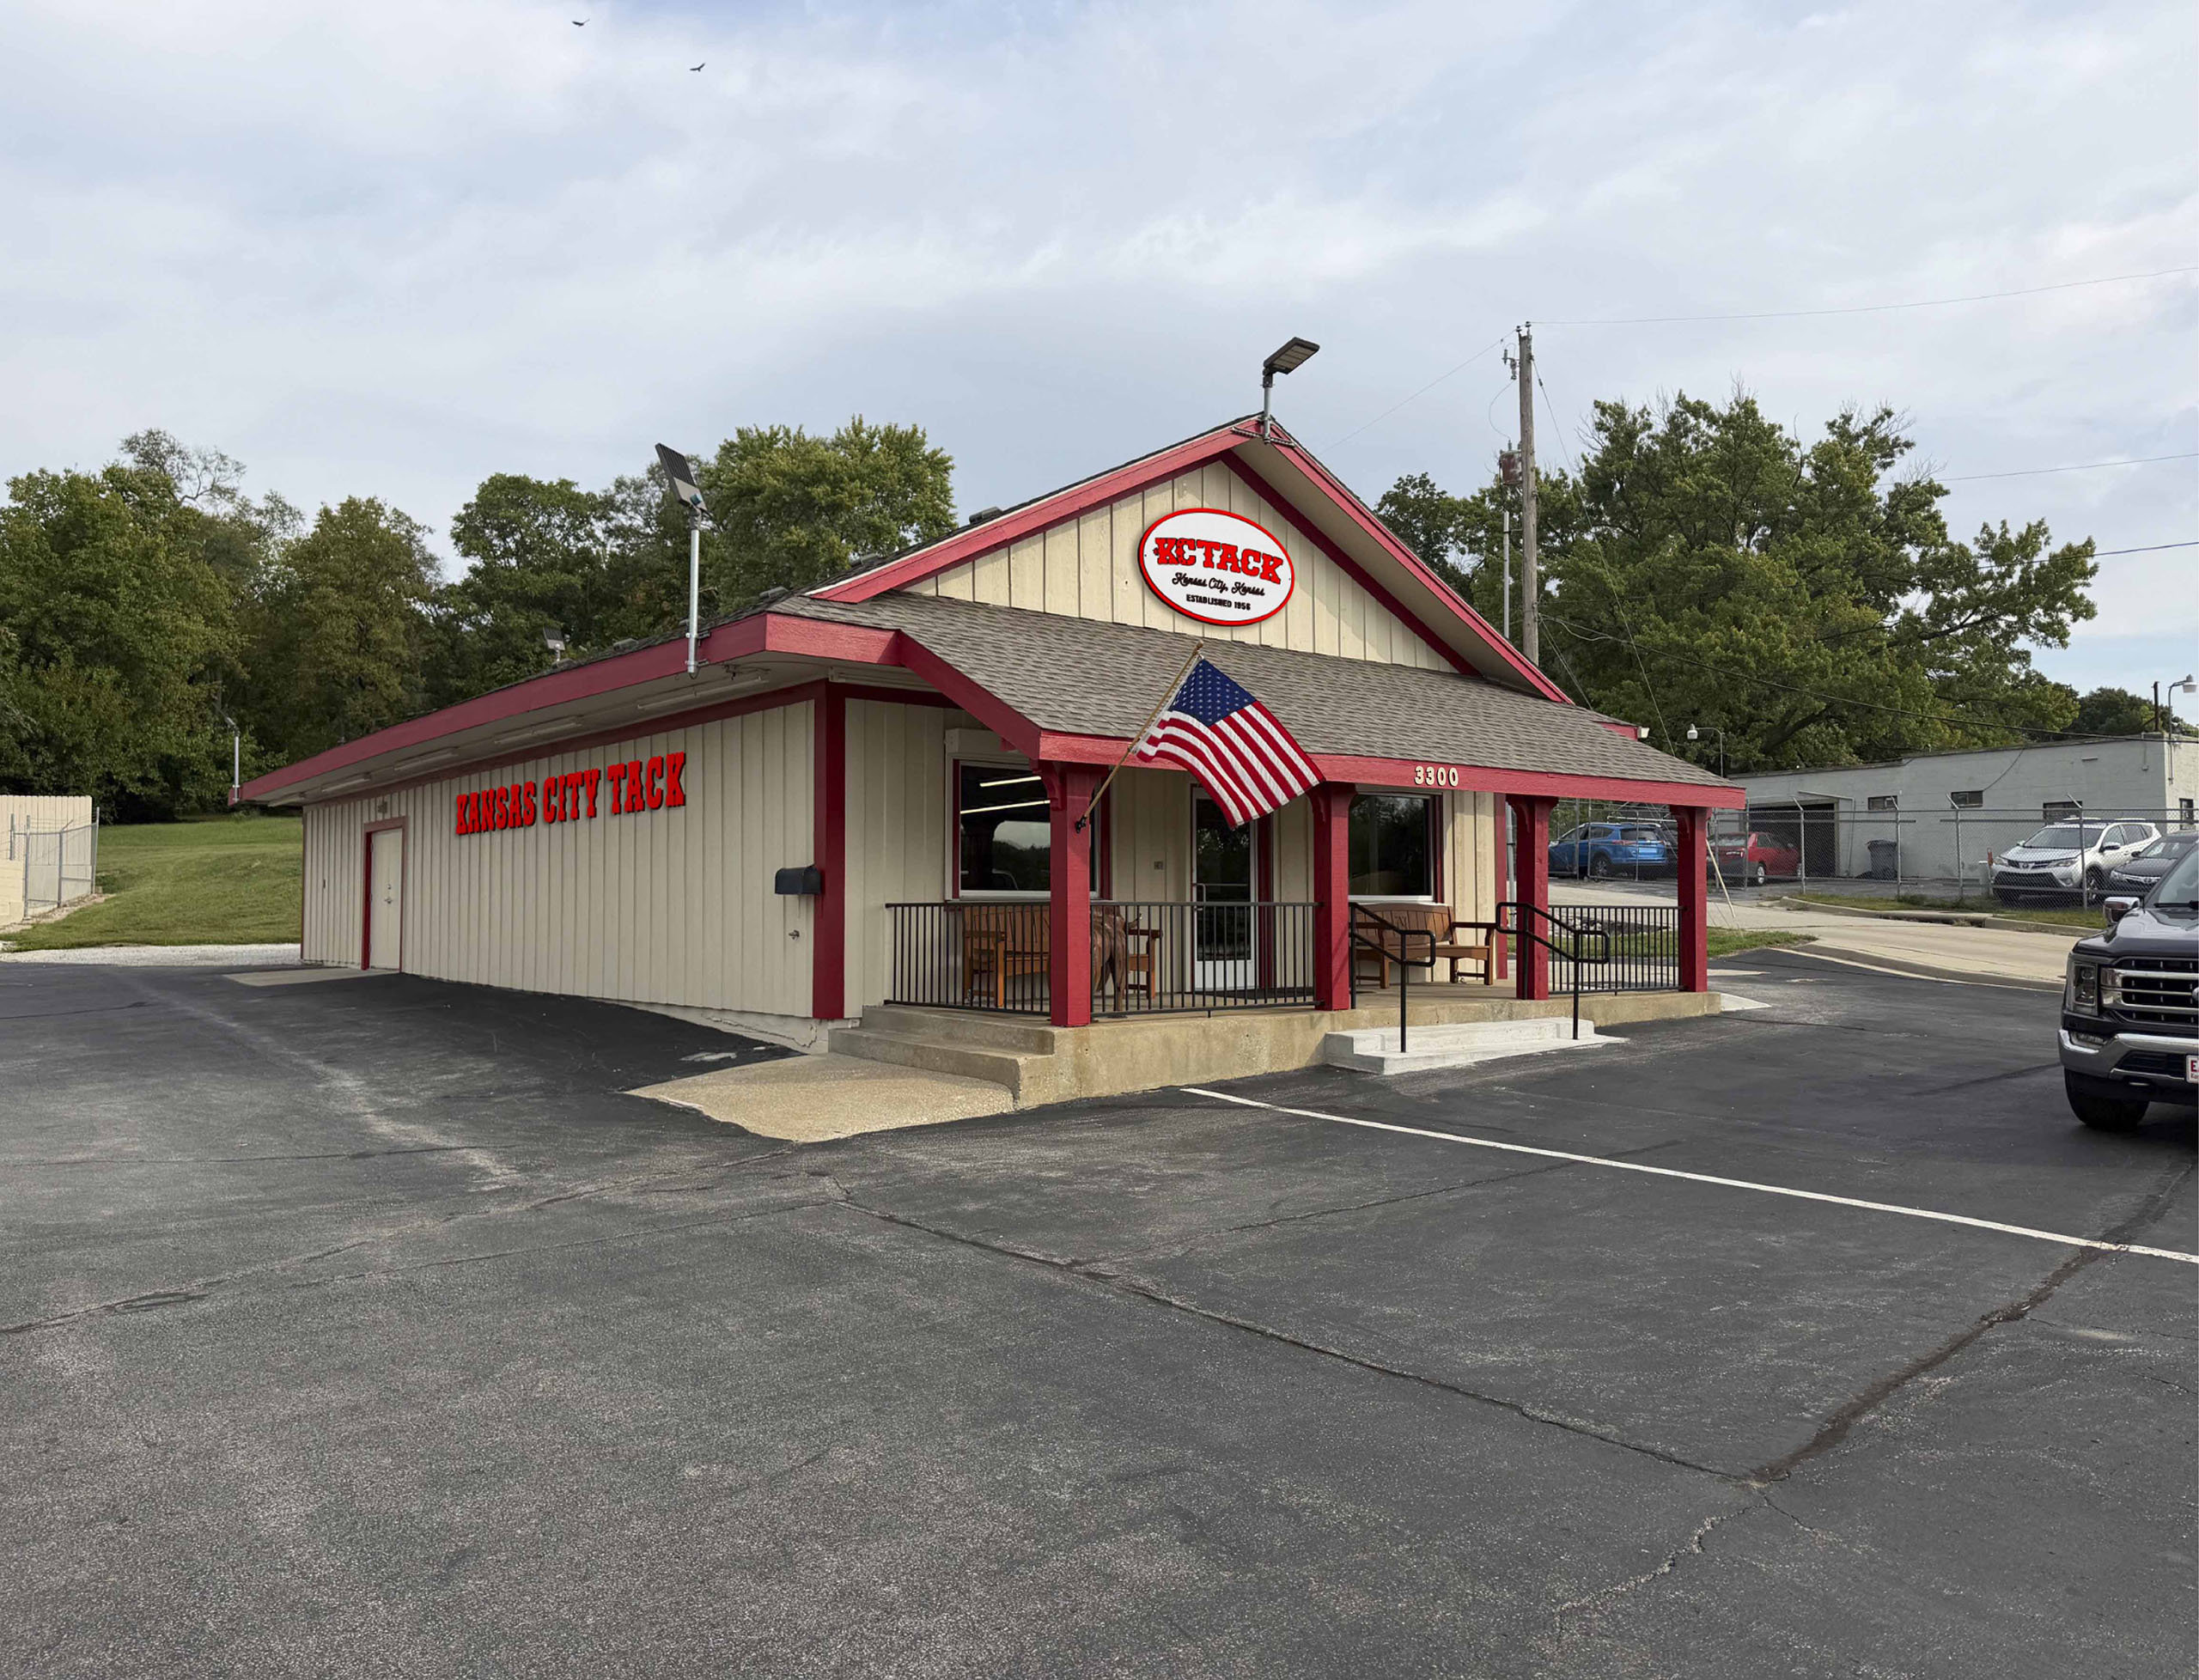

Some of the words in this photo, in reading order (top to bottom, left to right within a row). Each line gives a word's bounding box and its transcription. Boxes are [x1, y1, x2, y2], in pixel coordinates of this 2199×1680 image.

[1172, 572, 1208, 587] Kansas
[1231, 581, 1265, 596] Kansas
[1186, 593, 1233, 608] ESTABLISHED
[1414, 765, 1459, 787] 3300
[455, 781, 537, 836] KANSAS
[543, 768, 601, 825] CITY
[606, 751, 686, 815] TACK
